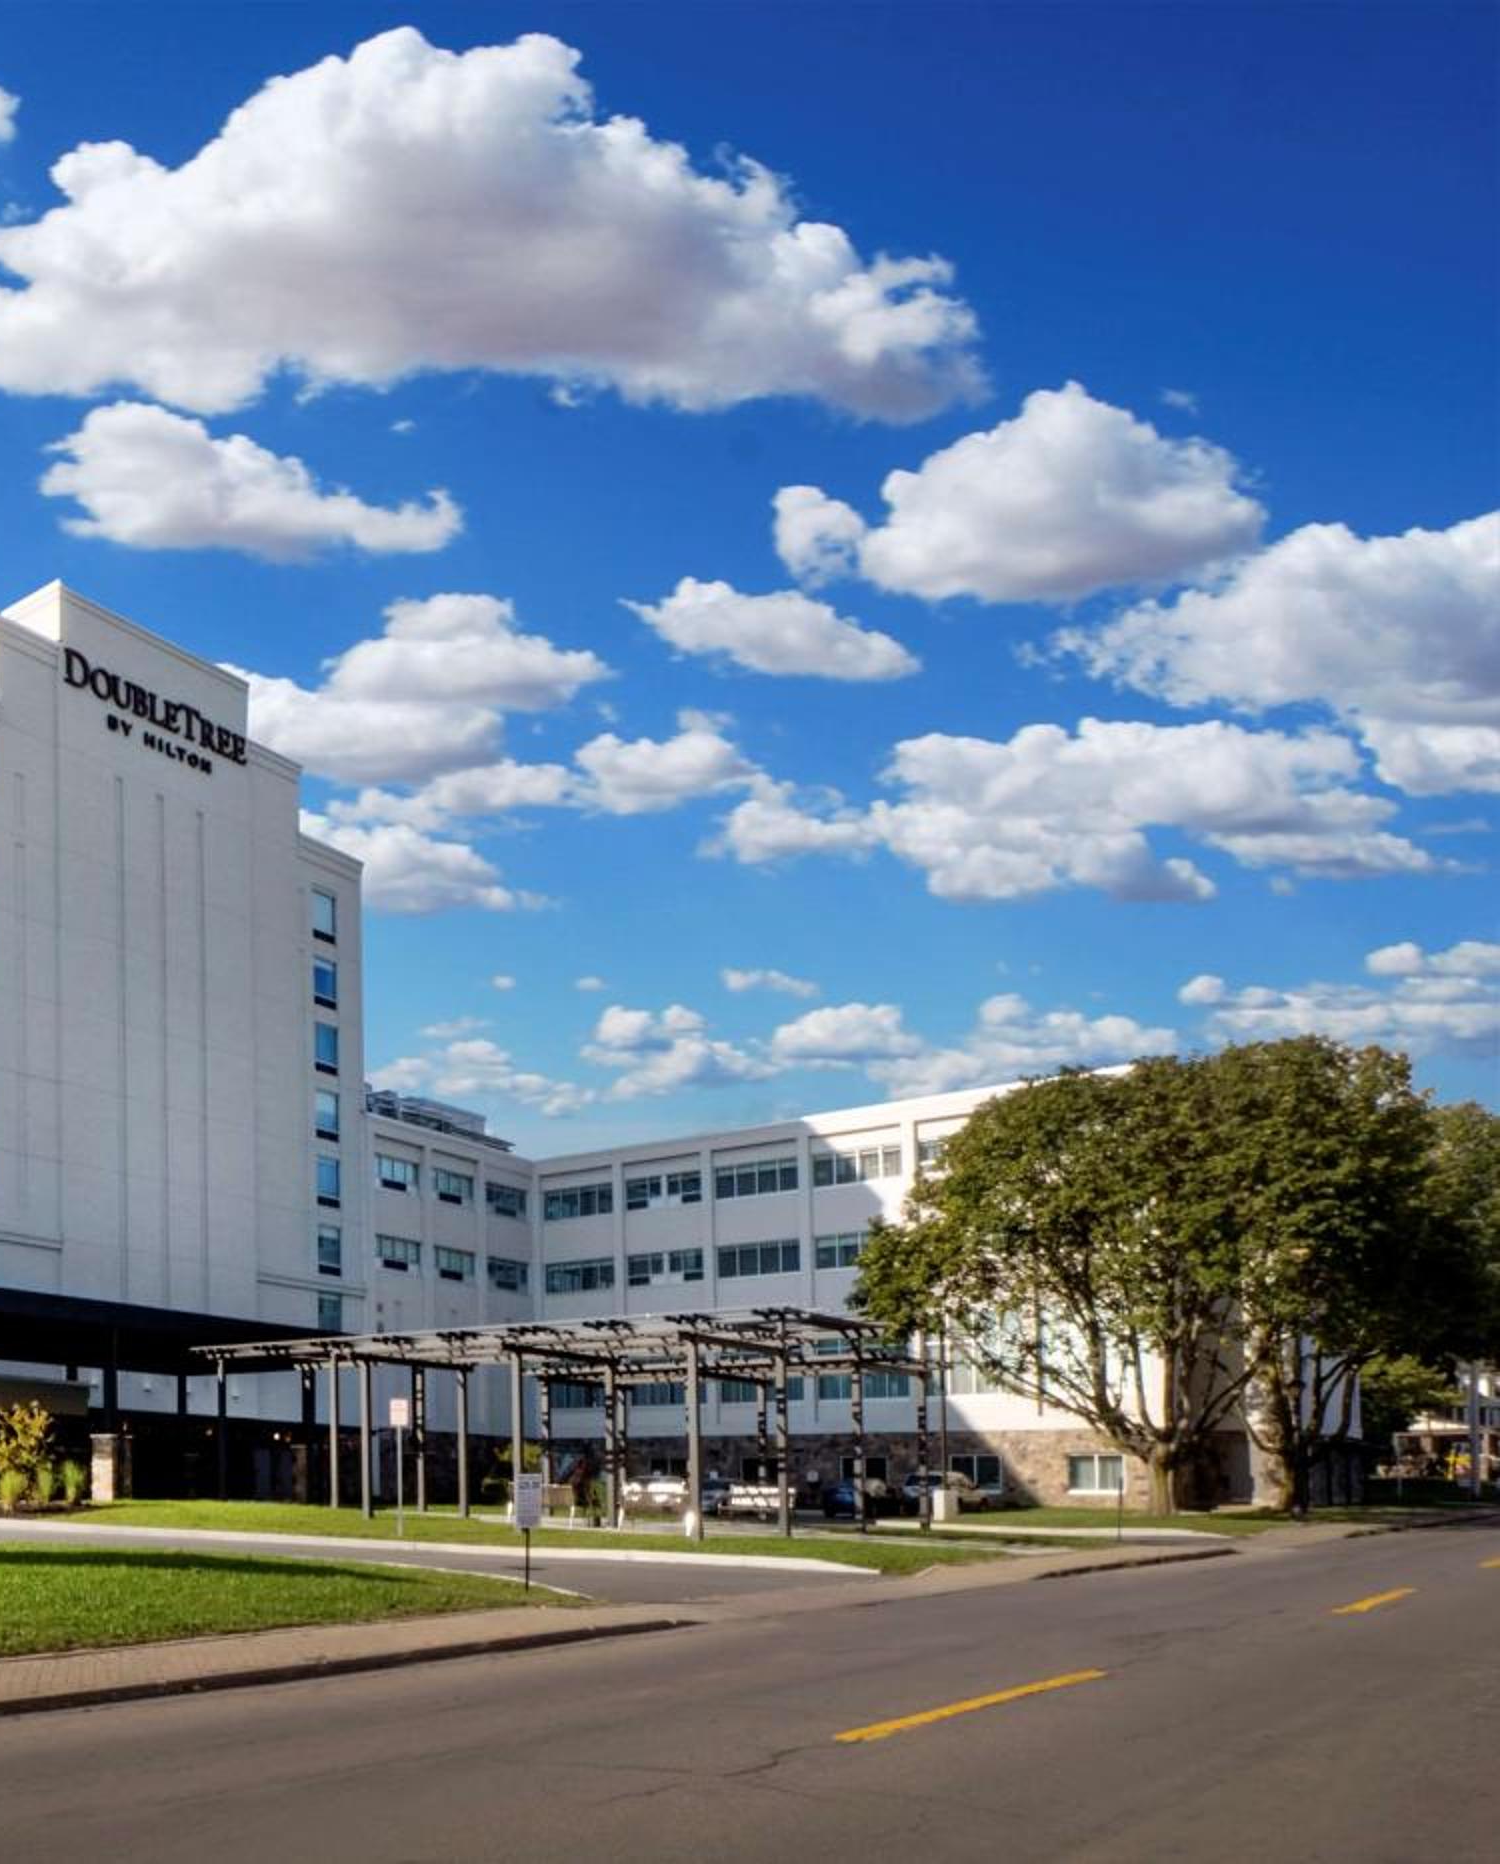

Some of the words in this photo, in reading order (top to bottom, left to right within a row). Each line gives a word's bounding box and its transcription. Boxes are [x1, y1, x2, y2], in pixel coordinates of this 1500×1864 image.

[64, 647, 248, 766] DOUBLETREE
[107, 713, 133, 737] BY
[143, 731, 213, 775] HILTON
